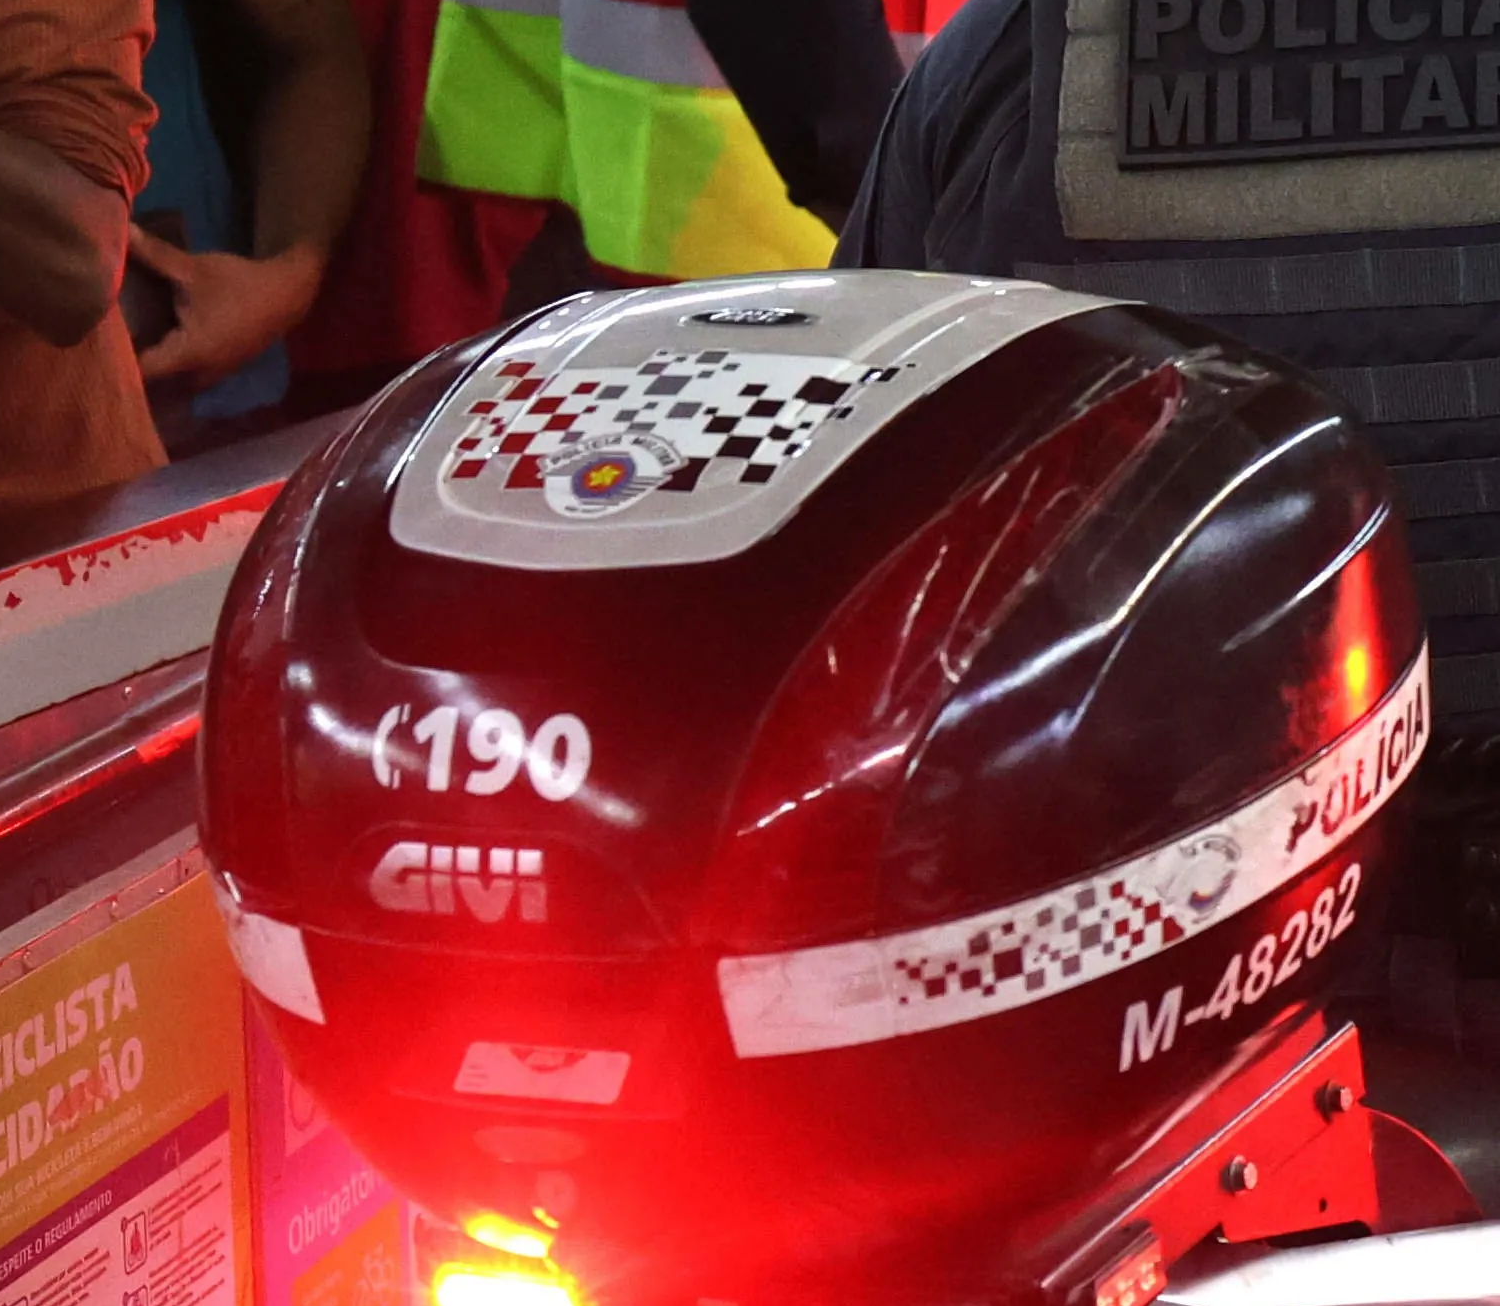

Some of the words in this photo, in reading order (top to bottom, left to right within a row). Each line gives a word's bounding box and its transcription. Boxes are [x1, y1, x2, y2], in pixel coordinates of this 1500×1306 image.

[412, 705, 593, 802] 190
[1284, 682, 1425, 854] POLÍCIA
[368, 841, 548, 924] GIVI
[1119, 862, 1362, 1073] M-48282
[35, 1237, 43, 1255] O
[44, 1188, 112, 1248] REGULAMENTO
